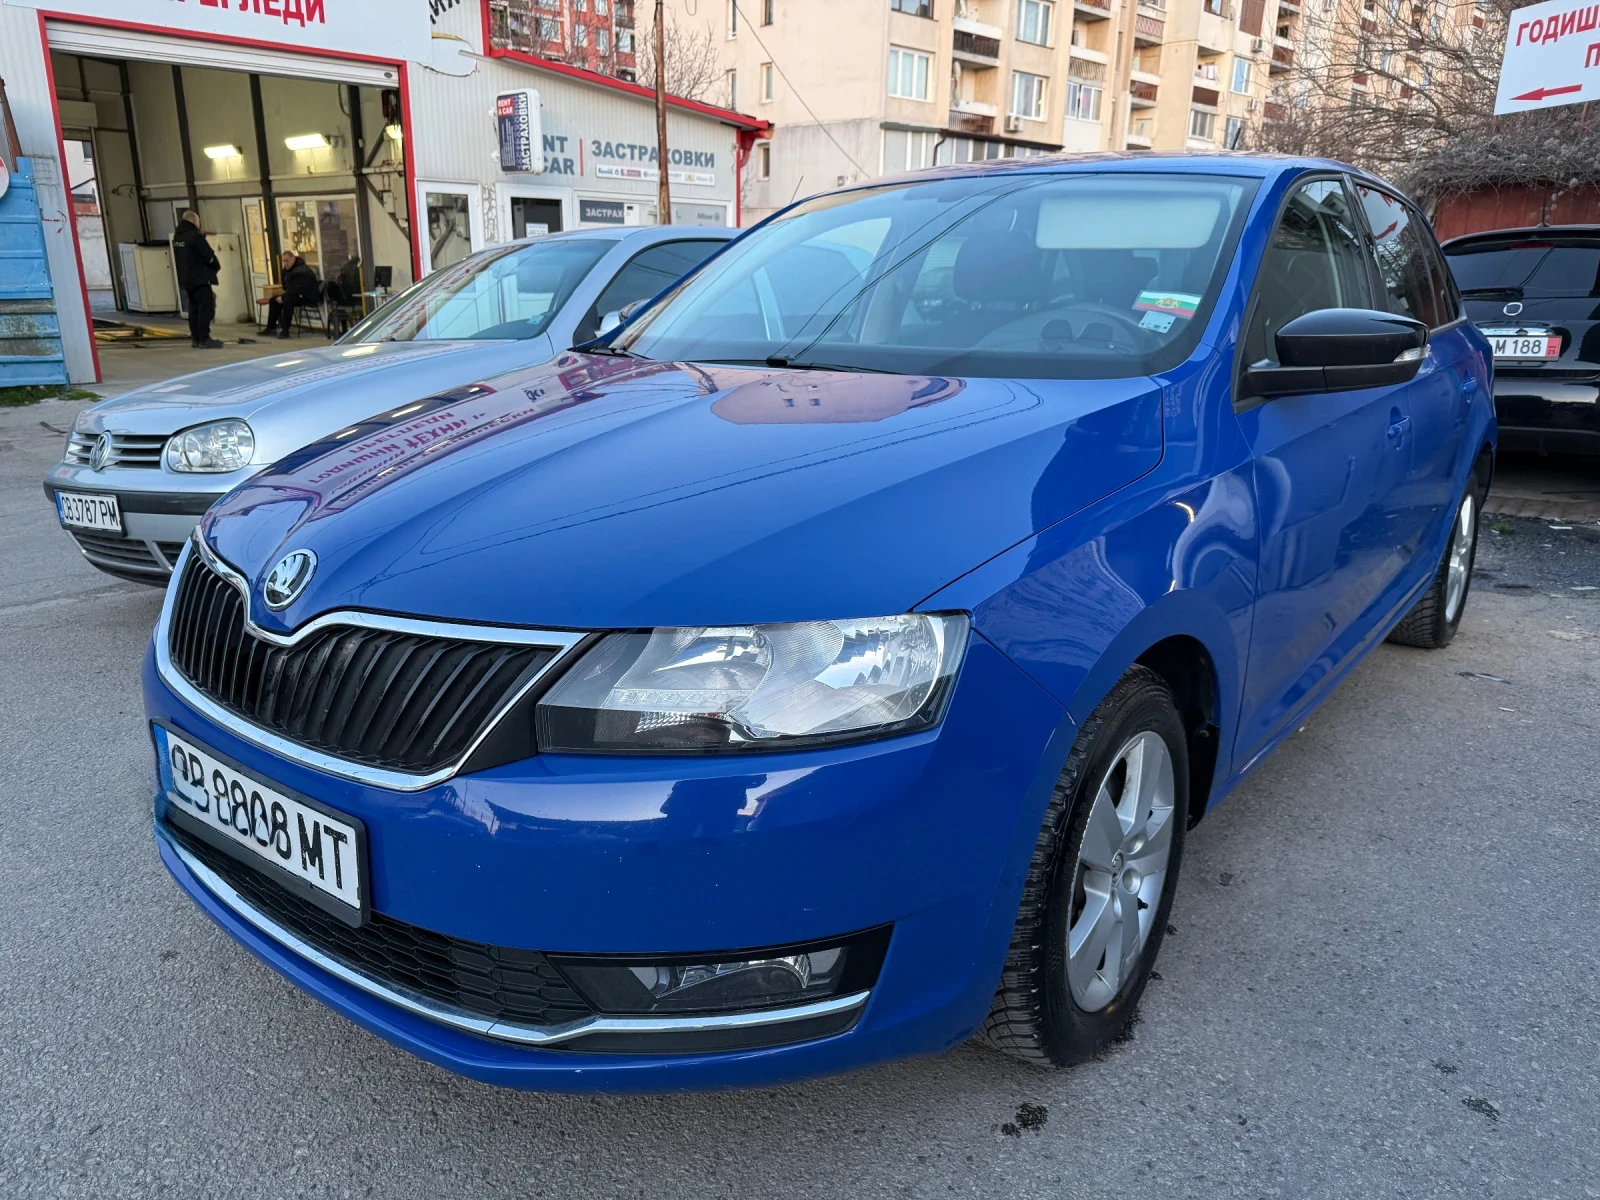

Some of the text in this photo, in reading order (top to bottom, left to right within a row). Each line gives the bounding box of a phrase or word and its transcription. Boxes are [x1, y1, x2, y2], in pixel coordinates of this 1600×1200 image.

[1516, 4, 1600, 46] ГОДИШ
[519, 93, 531, 171] ЗАСТРАХОВКИ
[543, 134, 568, 153] NT
[592, 140, 715, 168] ЗАСТРАОВКИ
[585, 208, 624, 218] ЗАСТРАХ
[1513, 340, 1541, 354] 188
[73, 498, 97, 524] 3787
[99, 500, 119, 527] PM
[297, 811, 348, 890] MT
